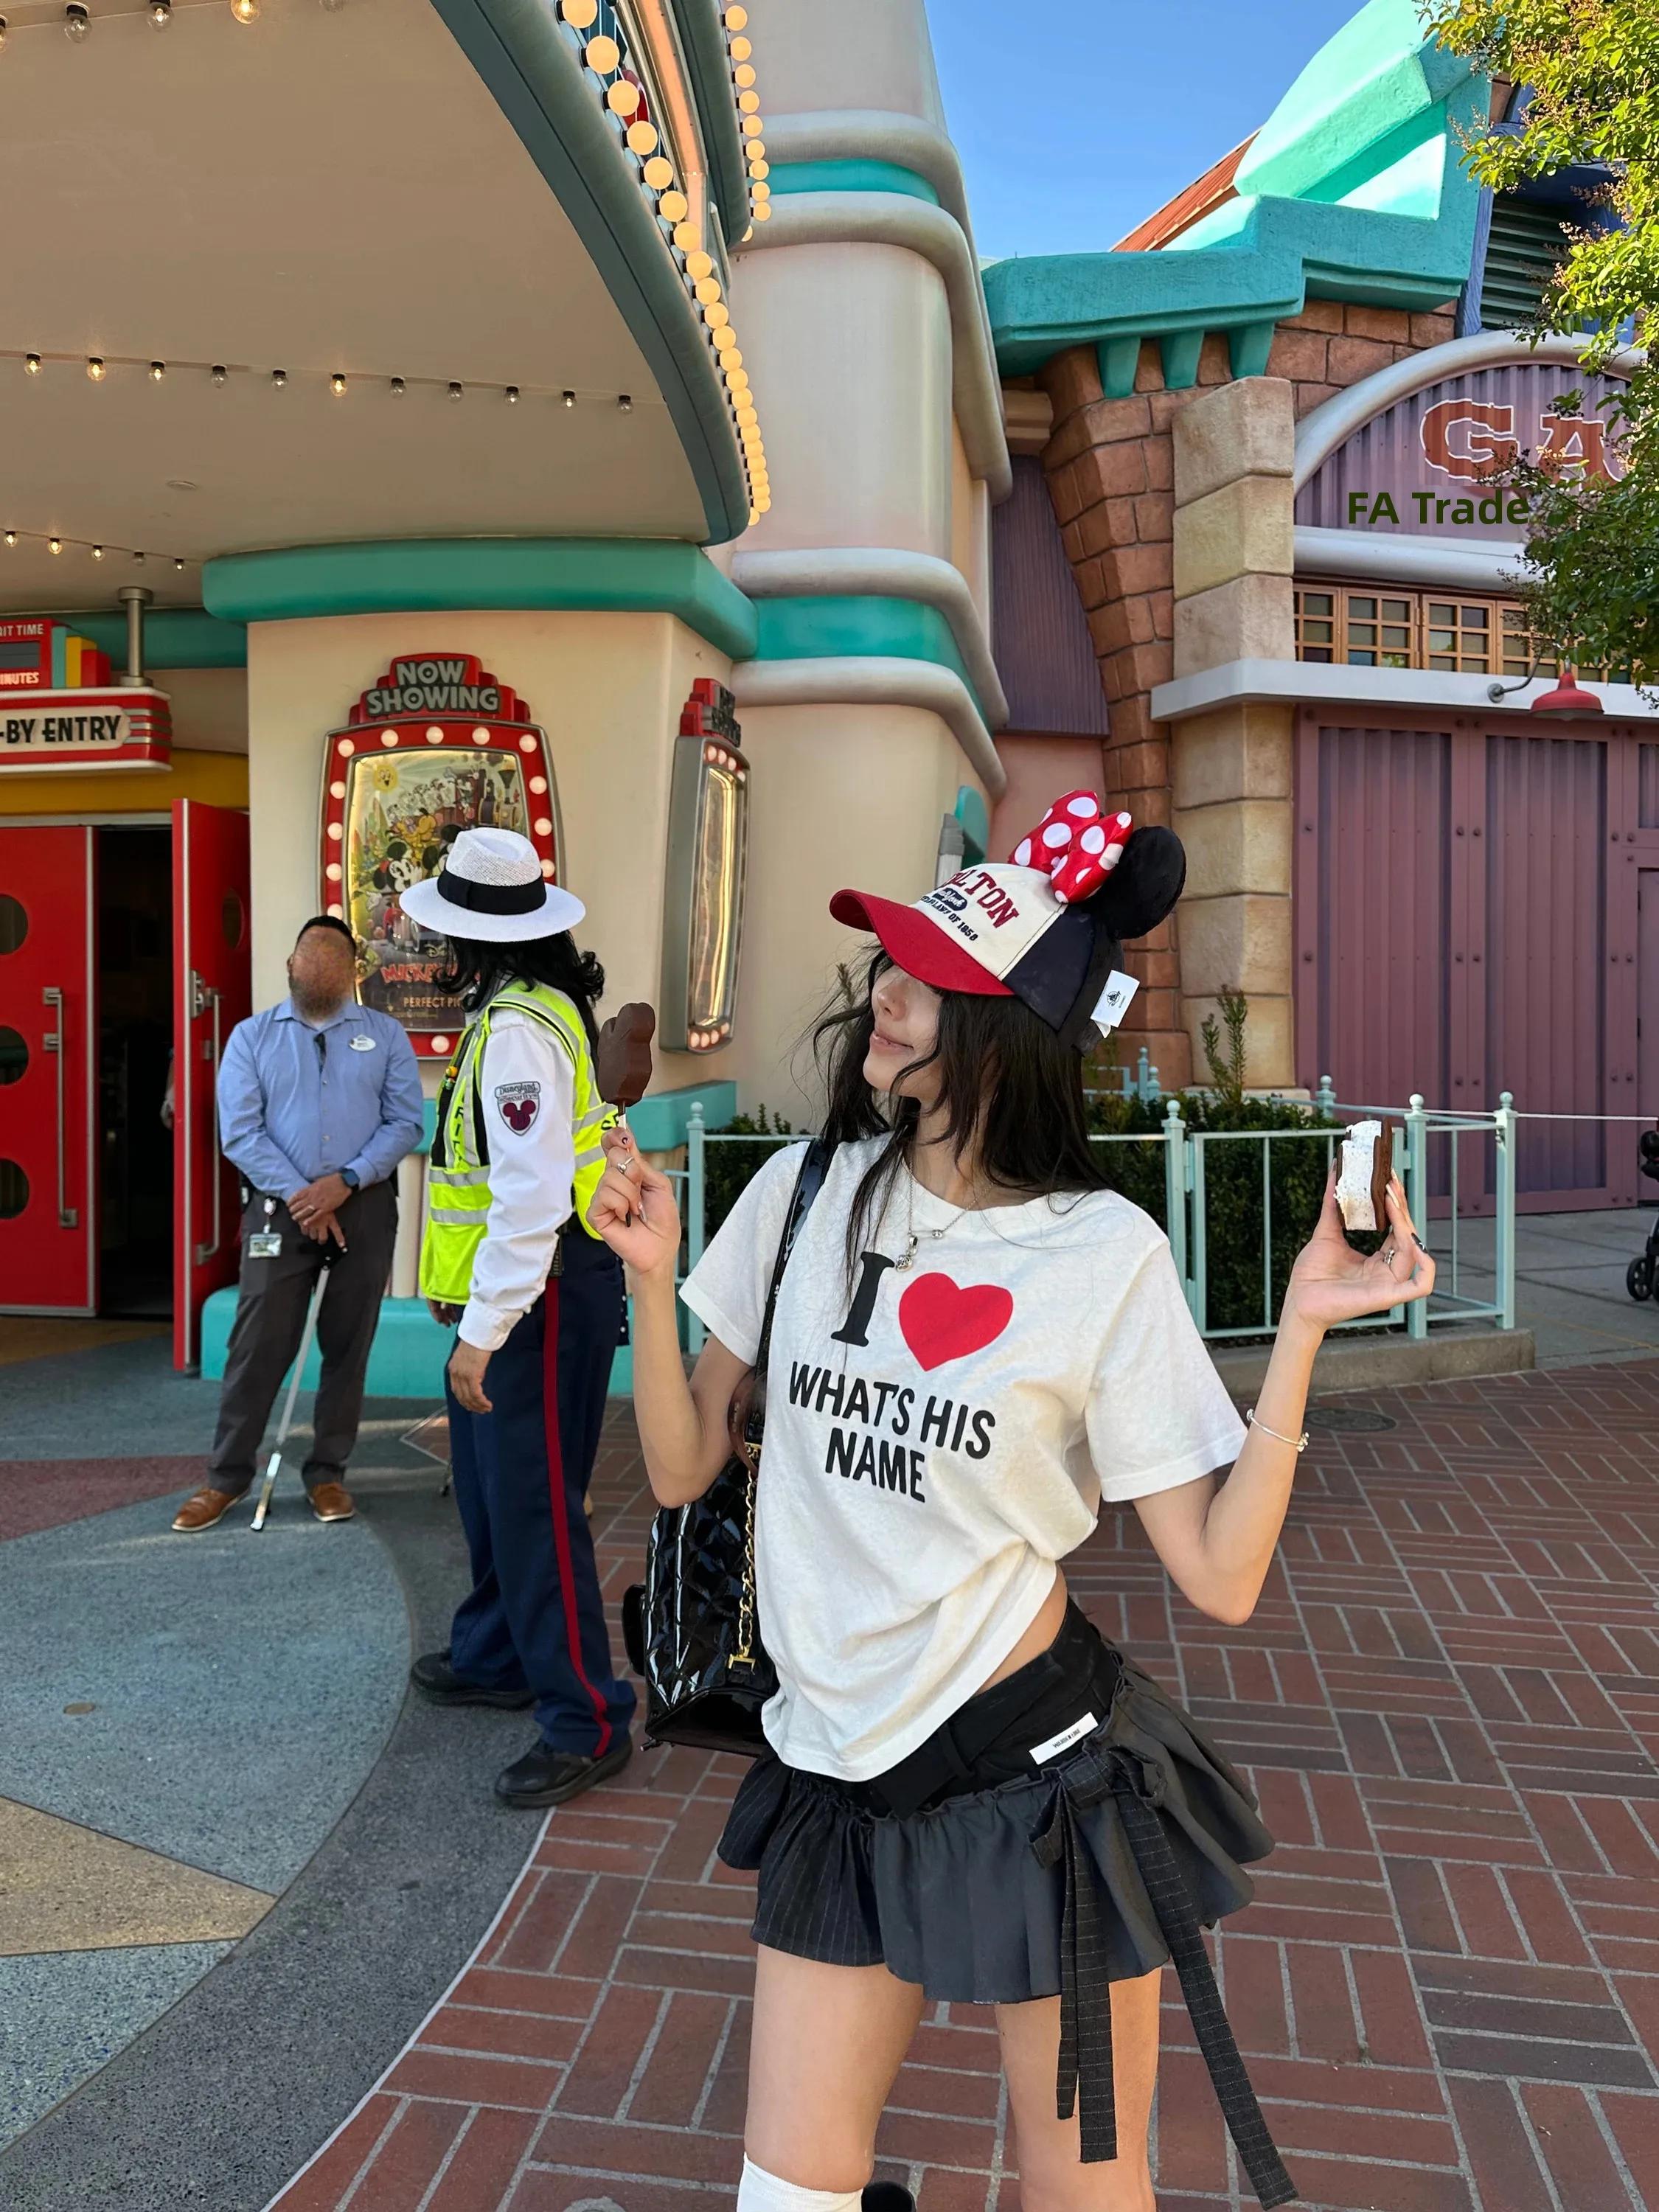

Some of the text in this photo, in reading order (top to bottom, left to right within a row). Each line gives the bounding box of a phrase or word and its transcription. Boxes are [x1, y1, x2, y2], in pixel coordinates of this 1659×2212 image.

[16, 623, 44, 636] TIME
[395, 661, 466, 686] NOW
[366, 686, 500, 714] SHOWING
[42, 715, 121, 742] ENTRY
[947, 913, 961, 923] OF
[403, 997, 445, 1009] PERFECT
[830, 1251, 895, 1347] I
[789, 1361, 996, 1460] WHAT'S HIS
[825, 1427, 925, 1503] NAME
